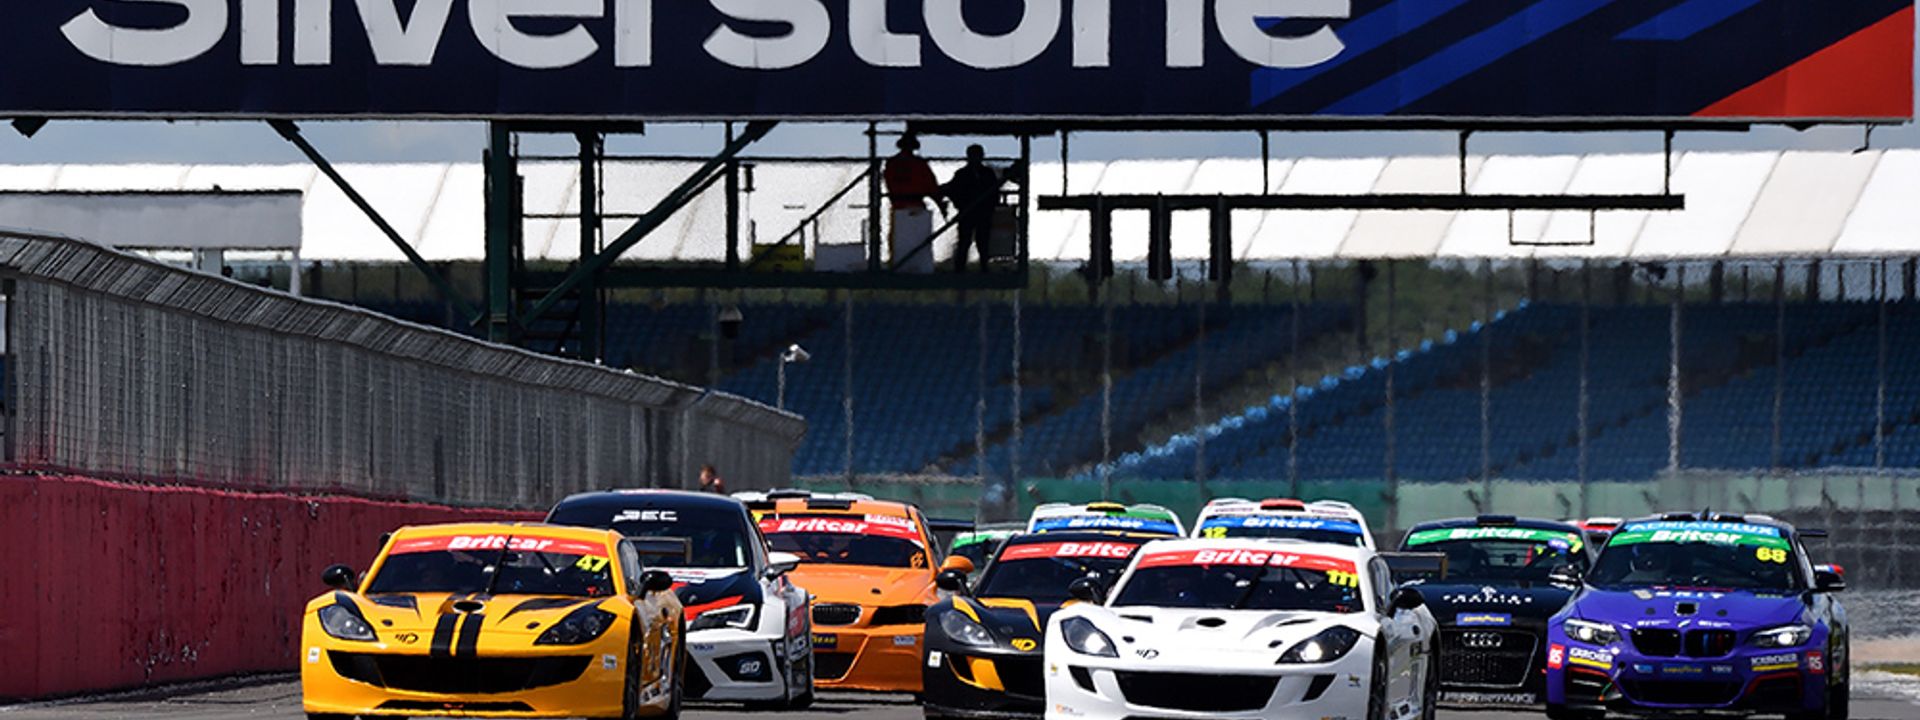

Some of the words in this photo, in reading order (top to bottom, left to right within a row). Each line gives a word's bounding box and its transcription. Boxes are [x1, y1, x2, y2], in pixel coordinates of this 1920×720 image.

[776, 518, 869, 534] Britcar
[1067, 517, 1145, 530] Britcar
[1242, 517, 1326, 530] Britcar
[1449, 526, 1537, 540] Britcar
[1649, 529, 1743, 543] Britcar
[447, 535, 554, 551] Britcar
[1055, 542, 1134, 558] Britc
[1192, 549, 1300, 567] Britcar
[1756, 546, 1787, 564] 68
[575, 554, 610, 573] 47
